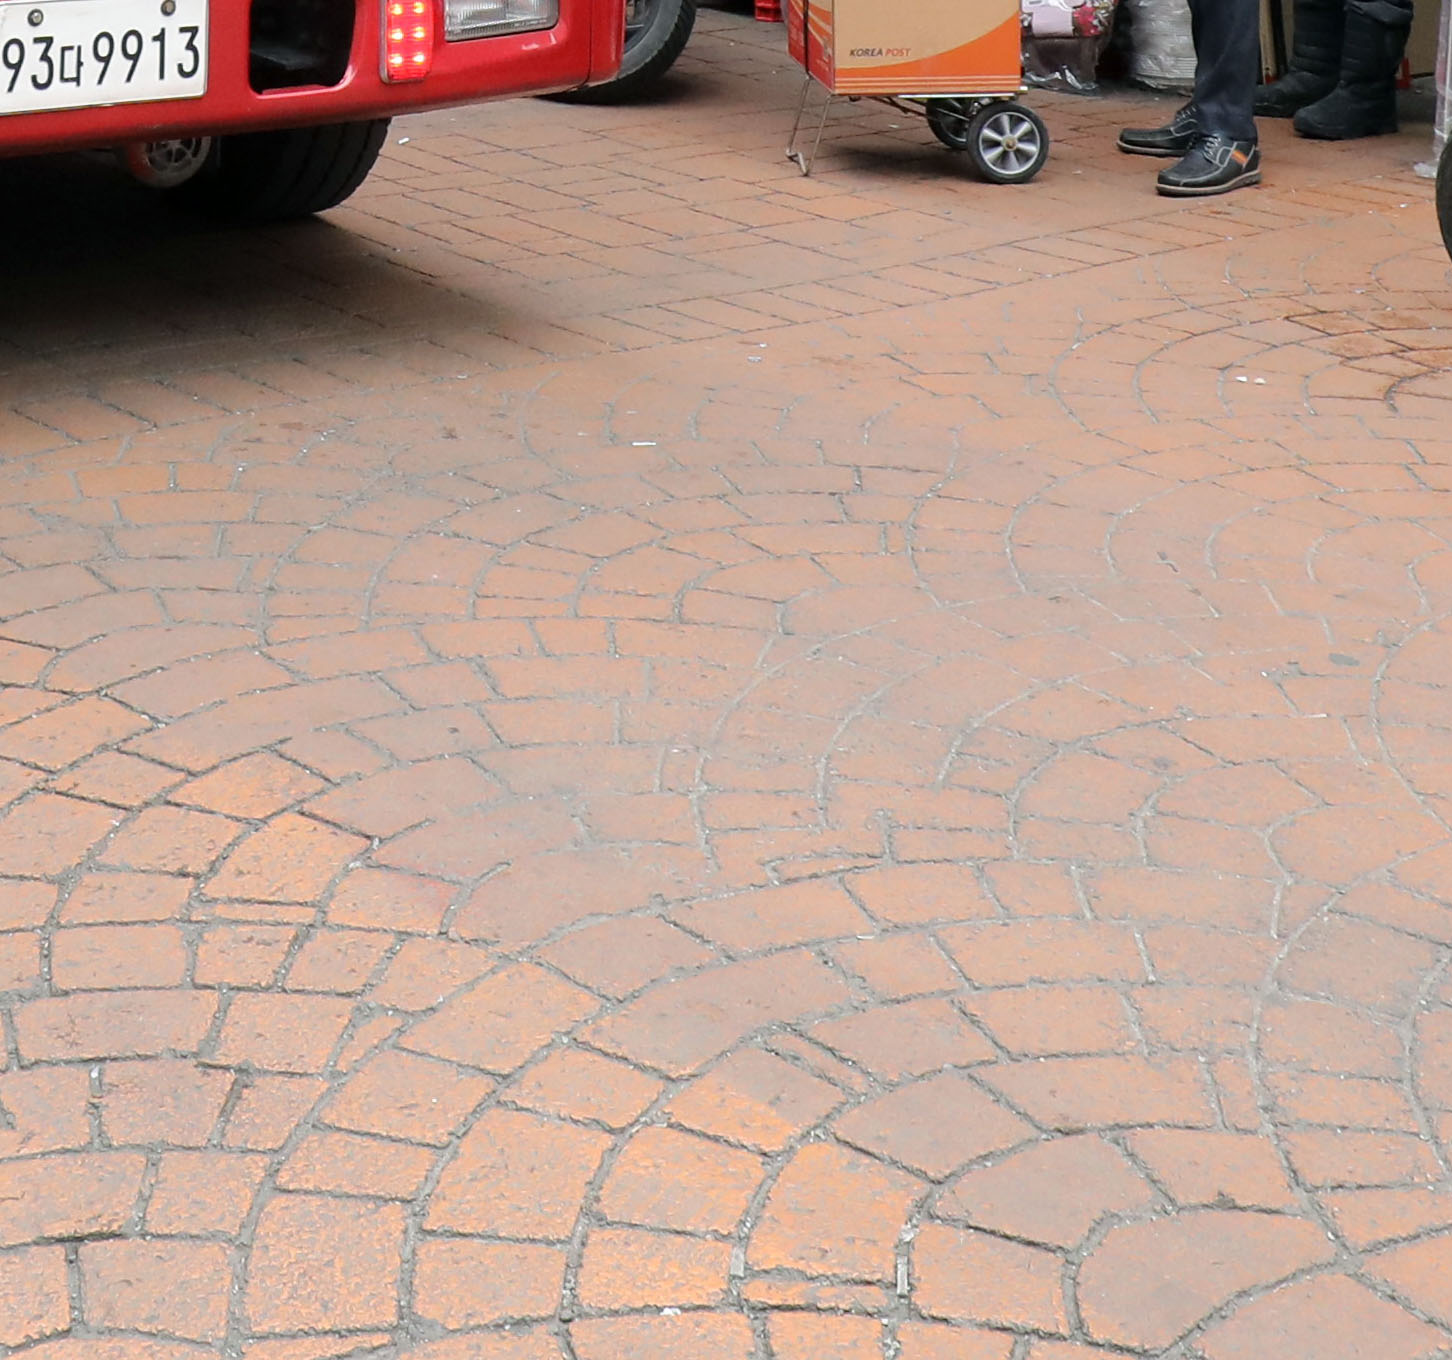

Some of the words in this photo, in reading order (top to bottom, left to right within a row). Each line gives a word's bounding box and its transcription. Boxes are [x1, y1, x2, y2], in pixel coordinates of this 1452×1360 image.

[2, 25, 200, 94] 93다9913
[849, 48, 884, 57] KOREA
[884, 47, 912, 57] POST
